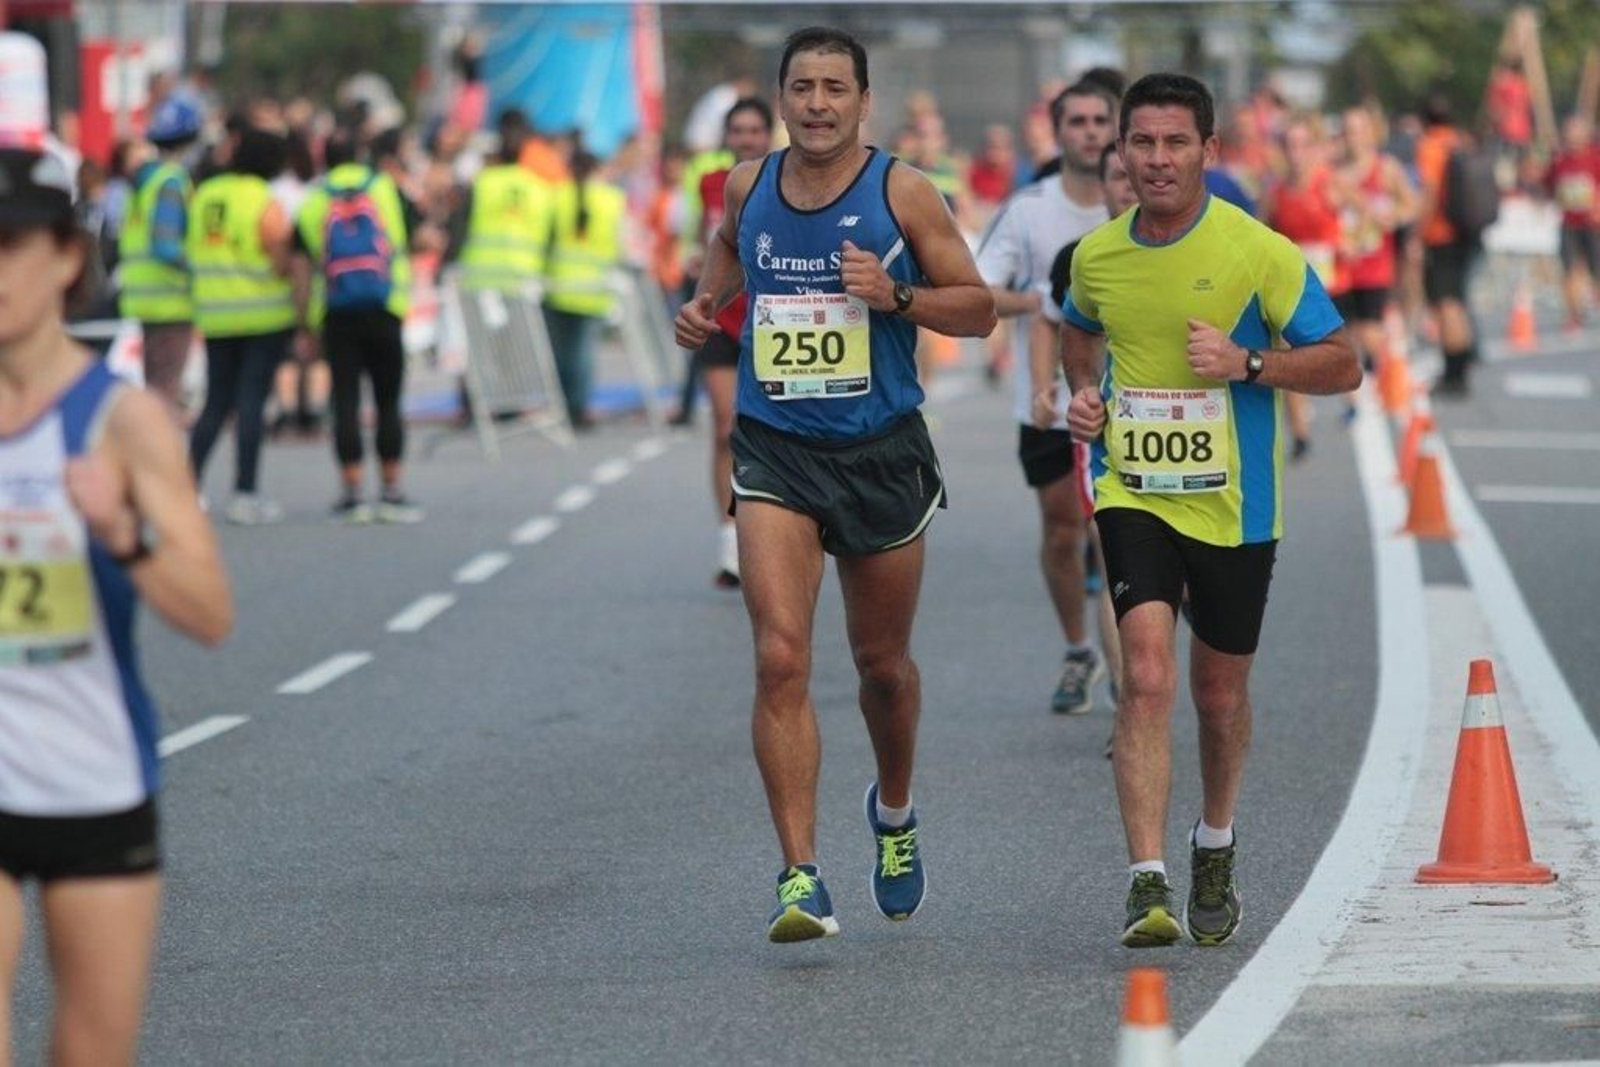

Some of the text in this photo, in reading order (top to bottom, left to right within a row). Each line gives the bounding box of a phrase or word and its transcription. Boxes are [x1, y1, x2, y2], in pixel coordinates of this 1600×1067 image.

[757, 251, 825, 271] Carmen
[772, 330, 845, 366] 250
[1123, 430, 1213, 463] 1008
